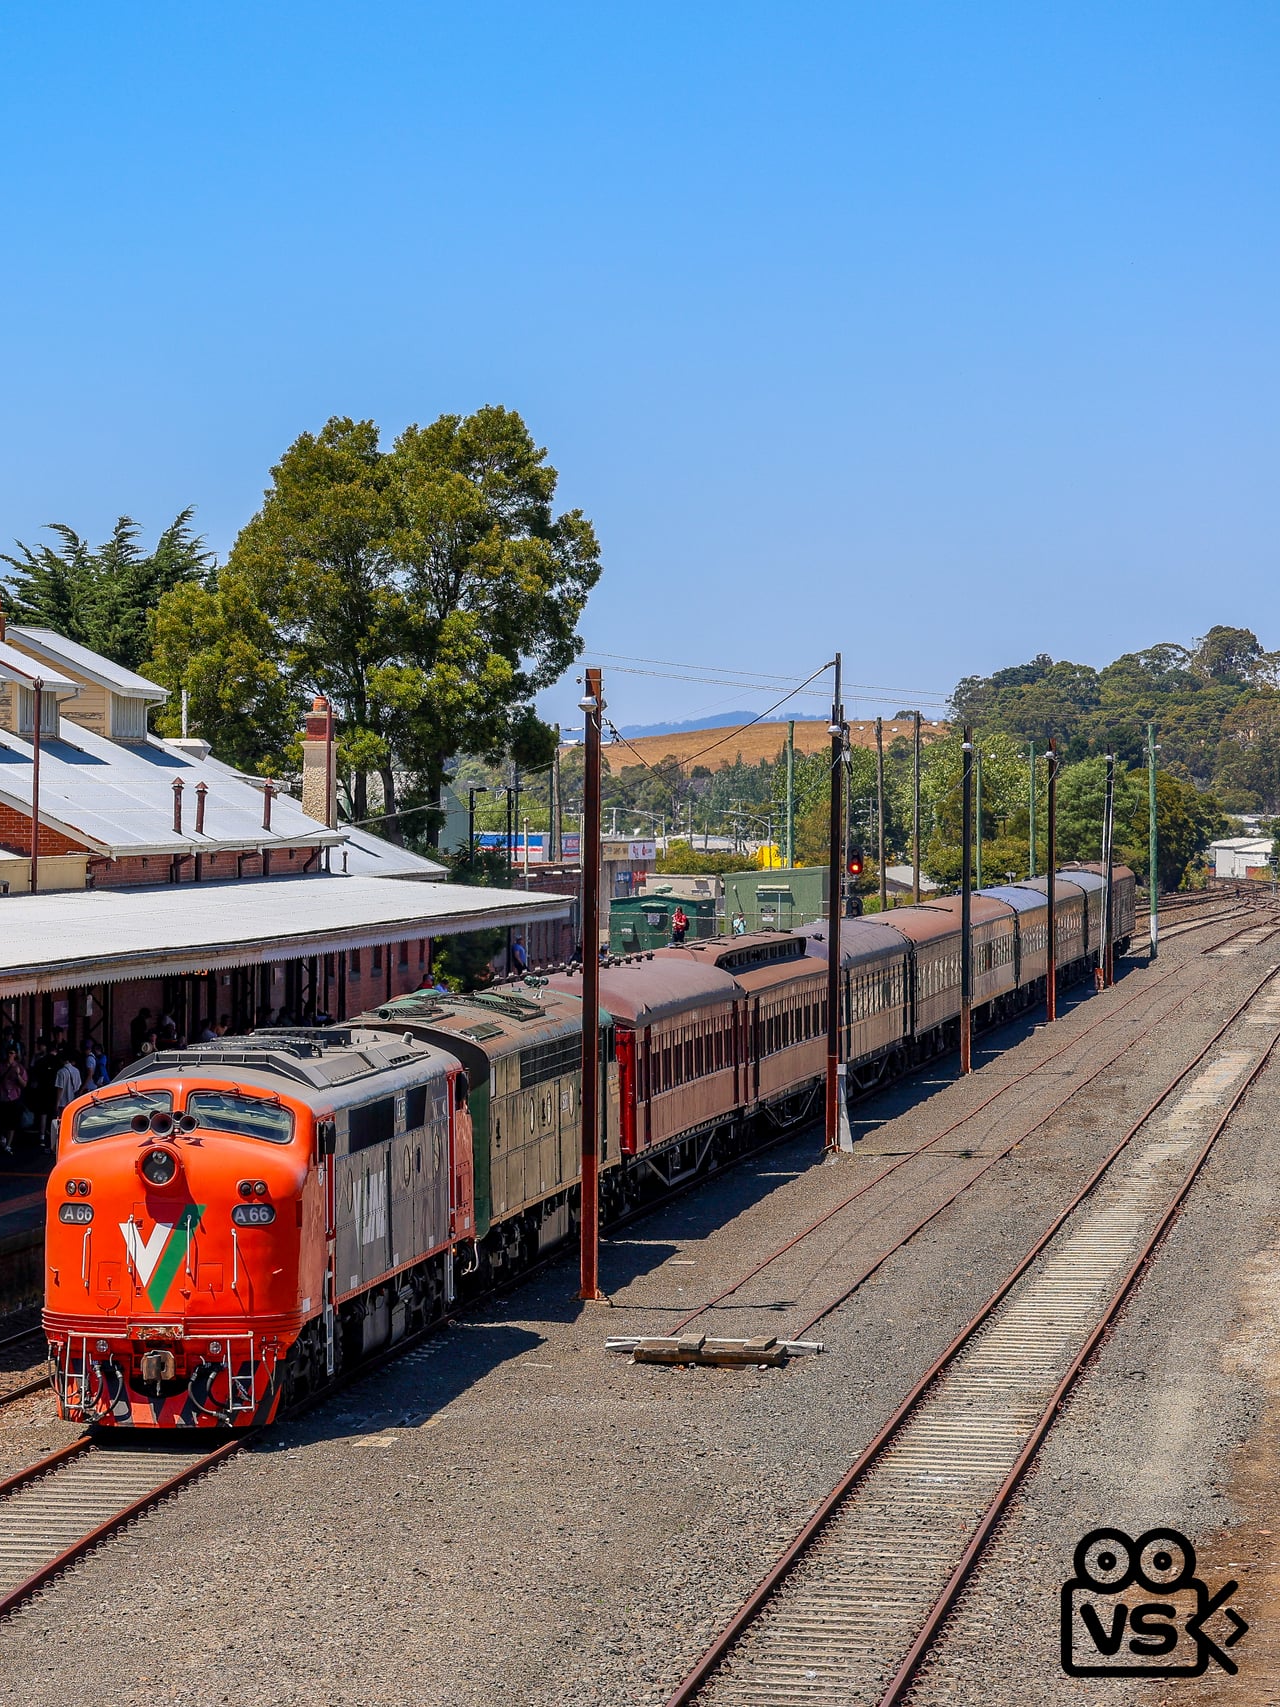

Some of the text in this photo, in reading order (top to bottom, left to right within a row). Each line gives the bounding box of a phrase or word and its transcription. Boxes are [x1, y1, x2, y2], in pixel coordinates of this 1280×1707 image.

[64, 1206, 92, 1221] A 66
[234, 1206, 270, 1222] A 66
